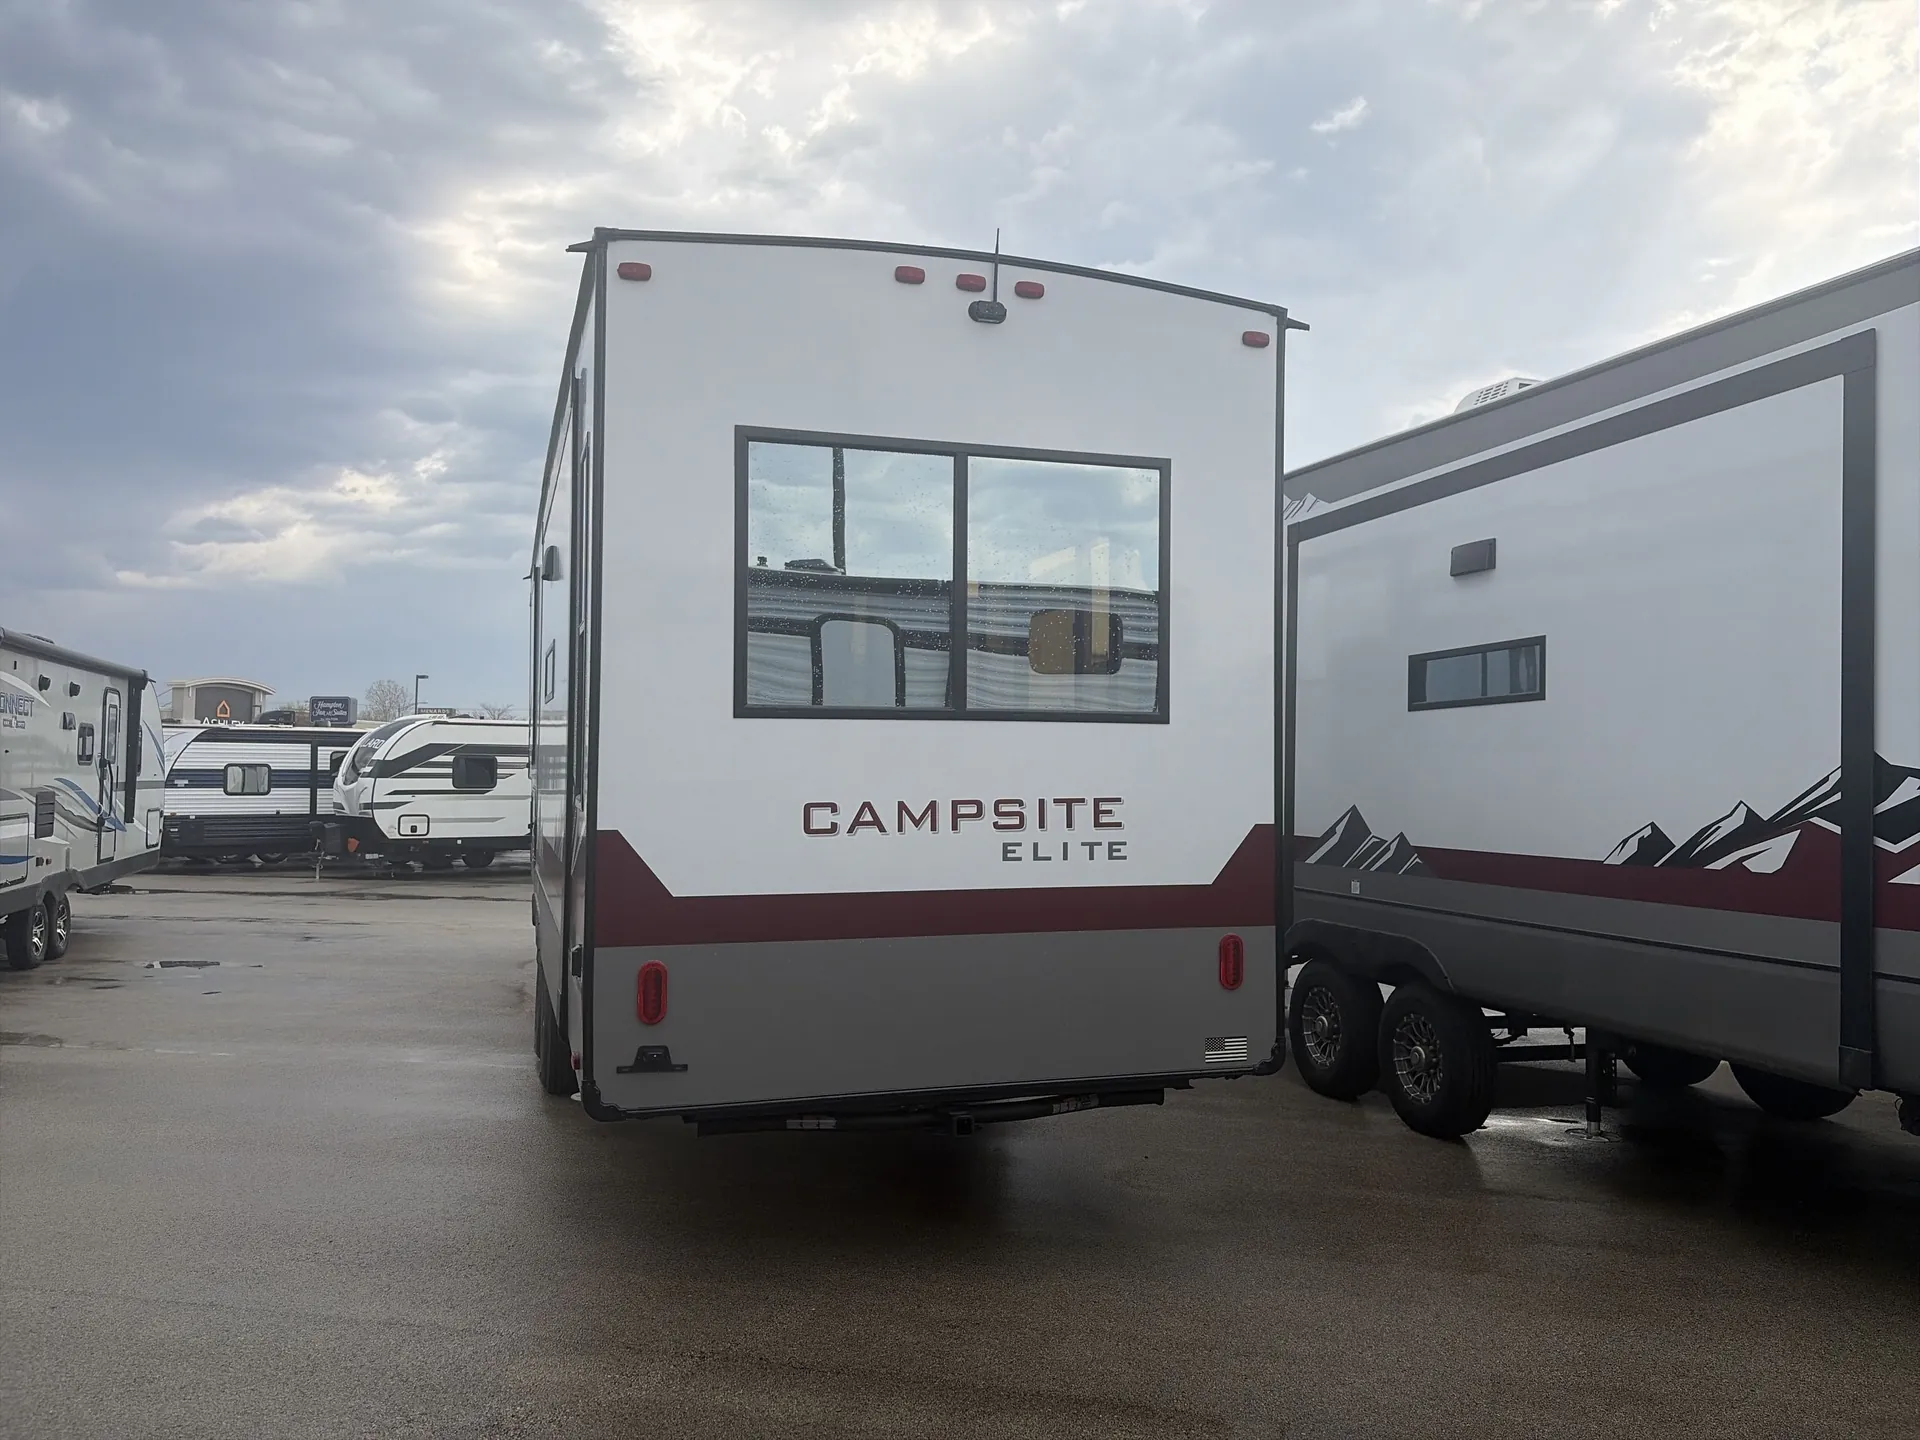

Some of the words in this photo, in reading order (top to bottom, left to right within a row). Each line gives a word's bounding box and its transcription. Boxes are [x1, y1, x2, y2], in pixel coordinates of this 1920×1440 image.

[314, 700, 345, 709] Hampton
[802, 797, 1125, 836] CAMPSITE
[1002, 841, 1128, 862] ELITE
